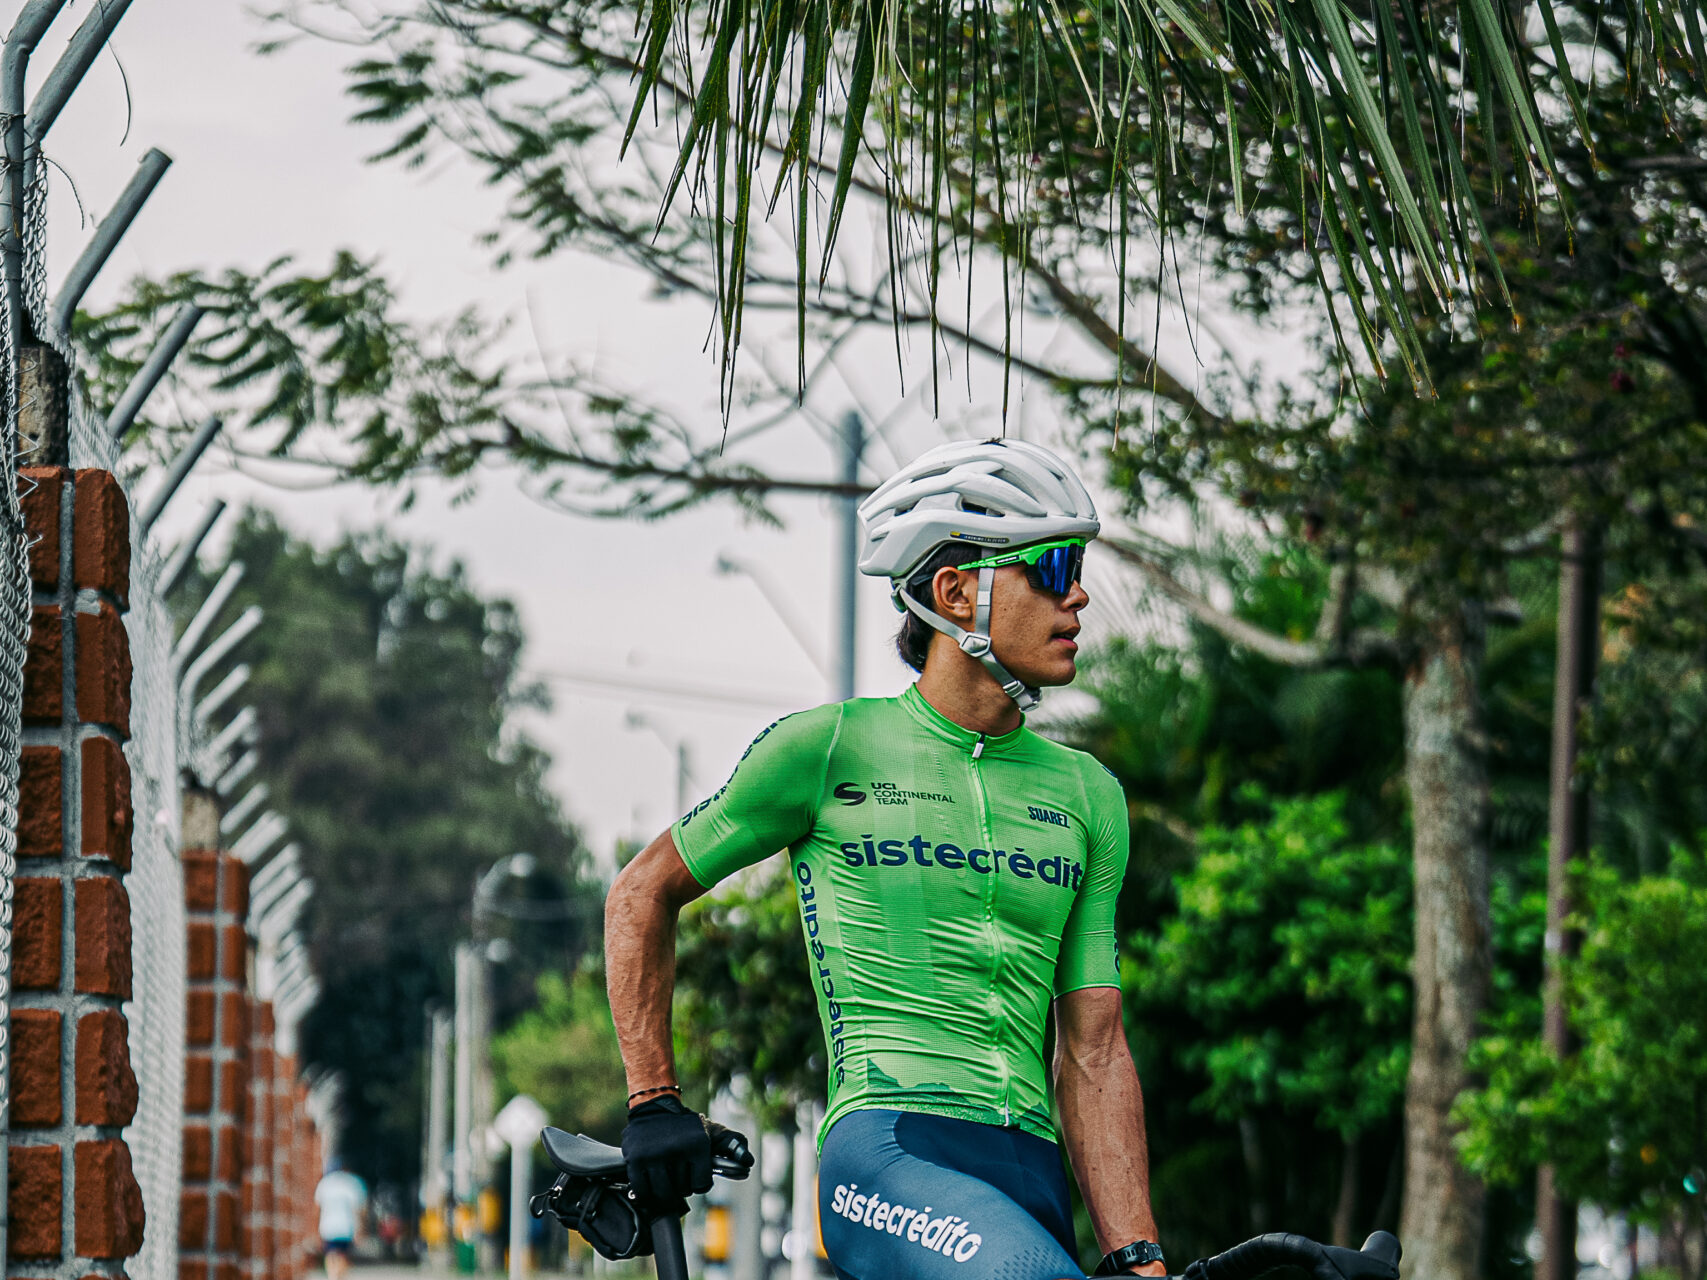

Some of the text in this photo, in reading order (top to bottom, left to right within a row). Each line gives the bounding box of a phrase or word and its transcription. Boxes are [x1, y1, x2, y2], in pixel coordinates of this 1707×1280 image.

[871, 782, 896, 790] UCI
[873, 790, 956, 804] CONTINENTAL
[875, 797, 909, 806] TEAM
[1027, 806, 1071, 829] SUAREZ
[840, 834, 1083, 892] sistecrédit
